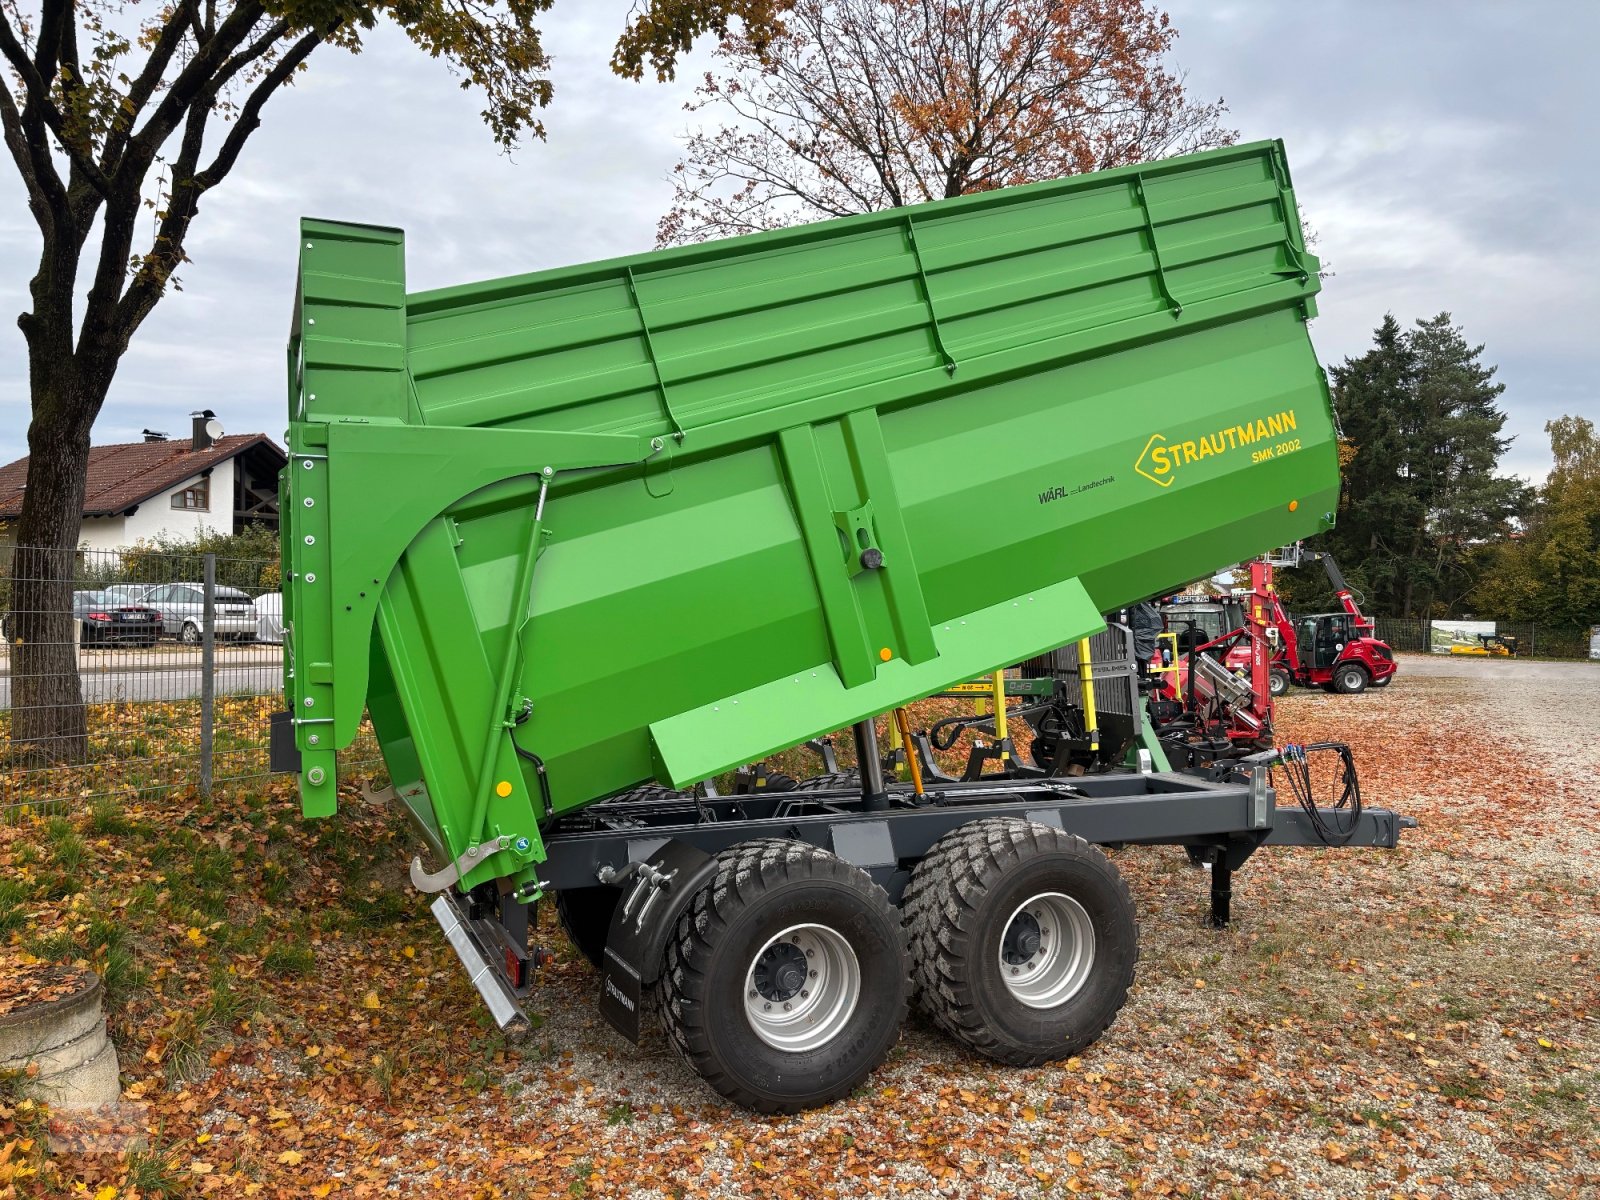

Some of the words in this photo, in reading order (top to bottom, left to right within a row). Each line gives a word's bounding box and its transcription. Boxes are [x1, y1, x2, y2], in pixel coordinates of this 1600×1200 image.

[1151, 409, 1298, 475] STRAUTMANN
[1251, 447, 1275, 464] SMK
[1275, 438, 1302, 457] 2002
[1038, 486, 1069, 505] WÄRL
[1077, 474, 1116, 493] Landtechnik
